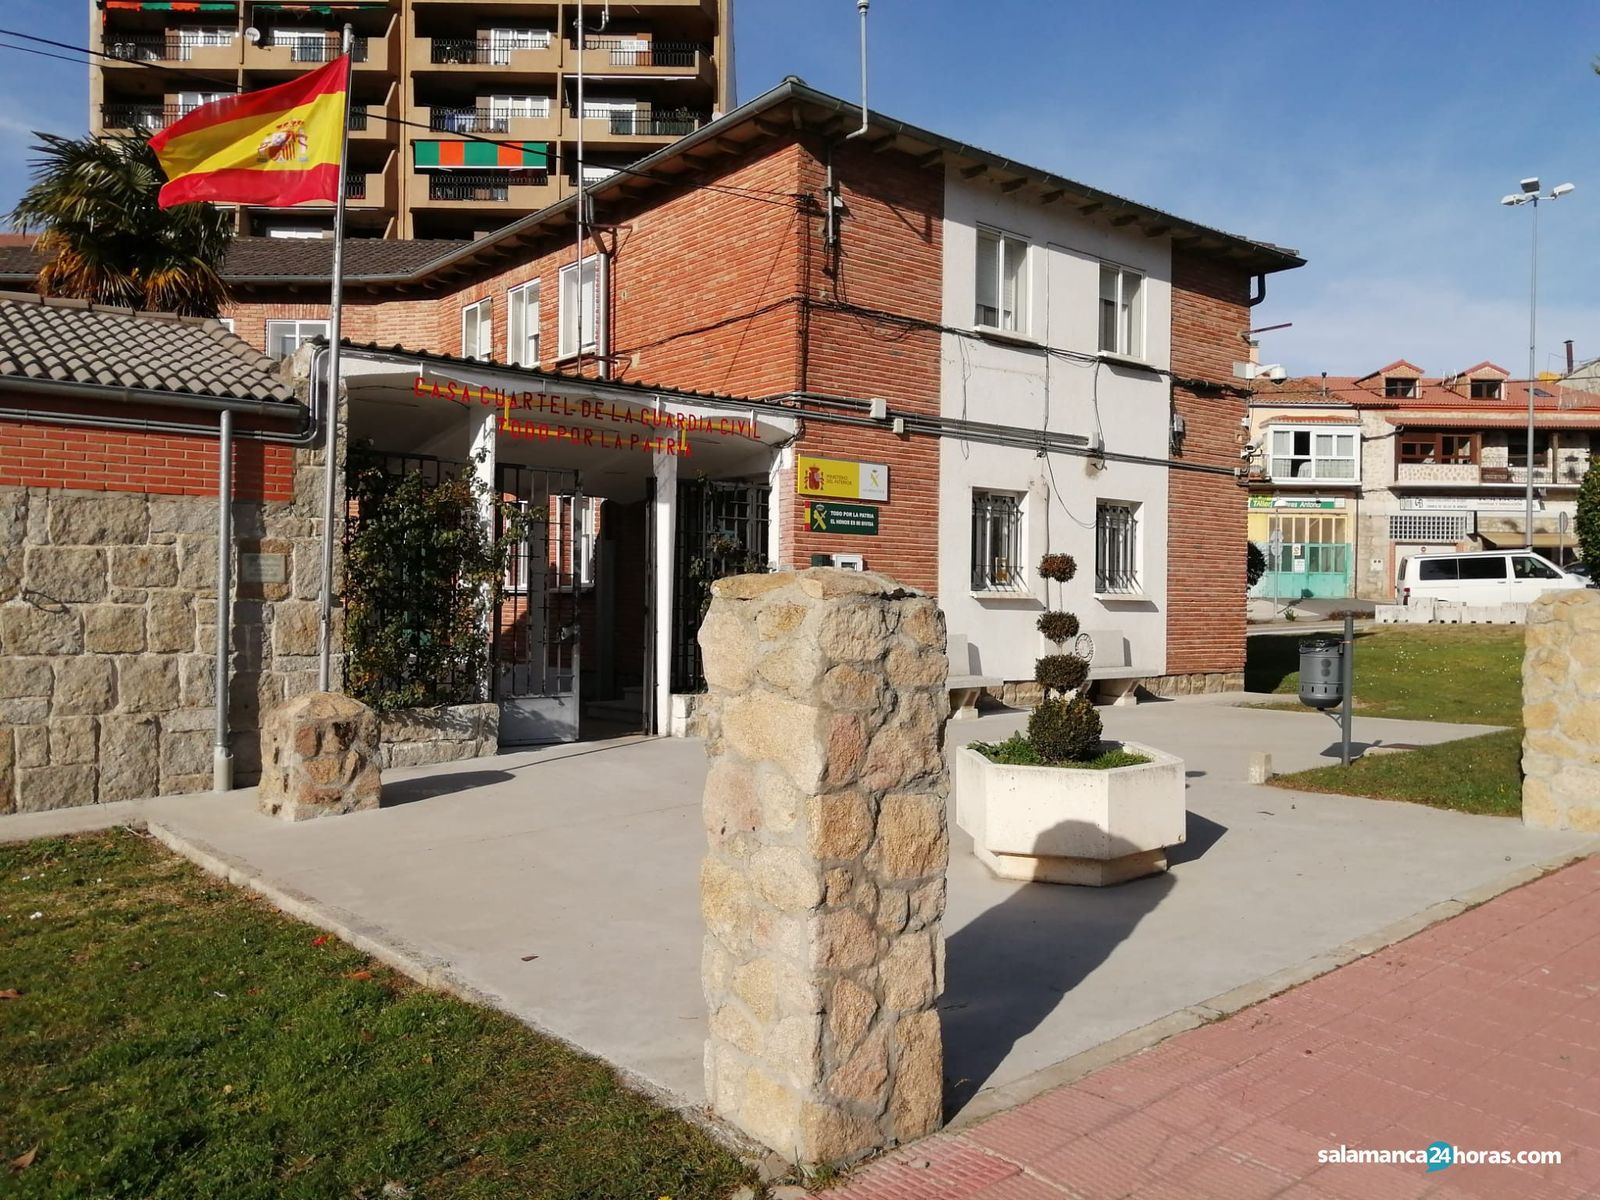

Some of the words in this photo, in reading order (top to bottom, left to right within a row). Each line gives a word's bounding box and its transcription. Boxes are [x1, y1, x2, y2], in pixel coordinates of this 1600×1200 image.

[413, 376, 471, 402] CASA
[479, 386, 574, 416] CUARTEL
[581, 400, 604, 420] DE
[611, 404, 633, 424] LA
[640, 408, 713, 434] GUARDIA
[720, 418, 761, 439] CIVIL
[497, 416, 549, 442] TODO
[557, 425, 593, 447] POR
[601, 431, 622, 450] LA
[630, 433, 693, 457] PATRIA
